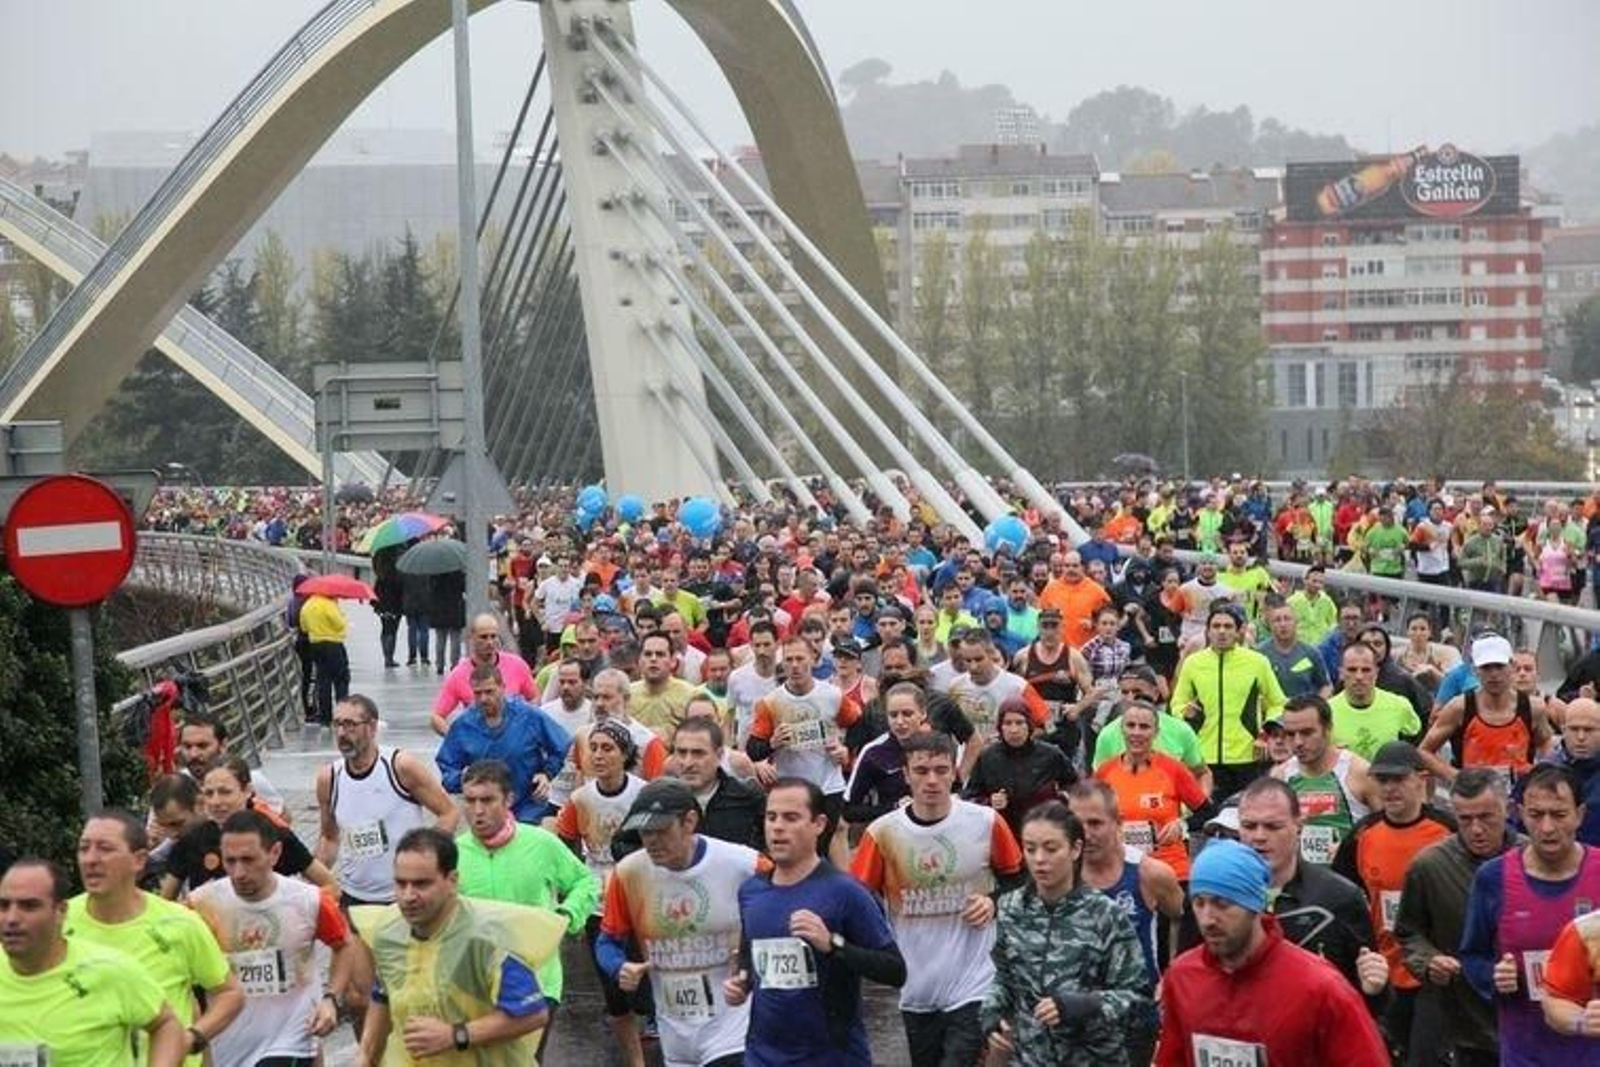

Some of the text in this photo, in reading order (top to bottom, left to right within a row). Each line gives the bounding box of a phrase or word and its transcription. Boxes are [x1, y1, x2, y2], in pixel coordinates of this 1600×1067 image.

[1414, 164, 1485, 182] Estrella
[1417, 181, 1480, 202] Galicia
[772, 953, 800, 975] 732
[677, 989, 699, 1007] 412
